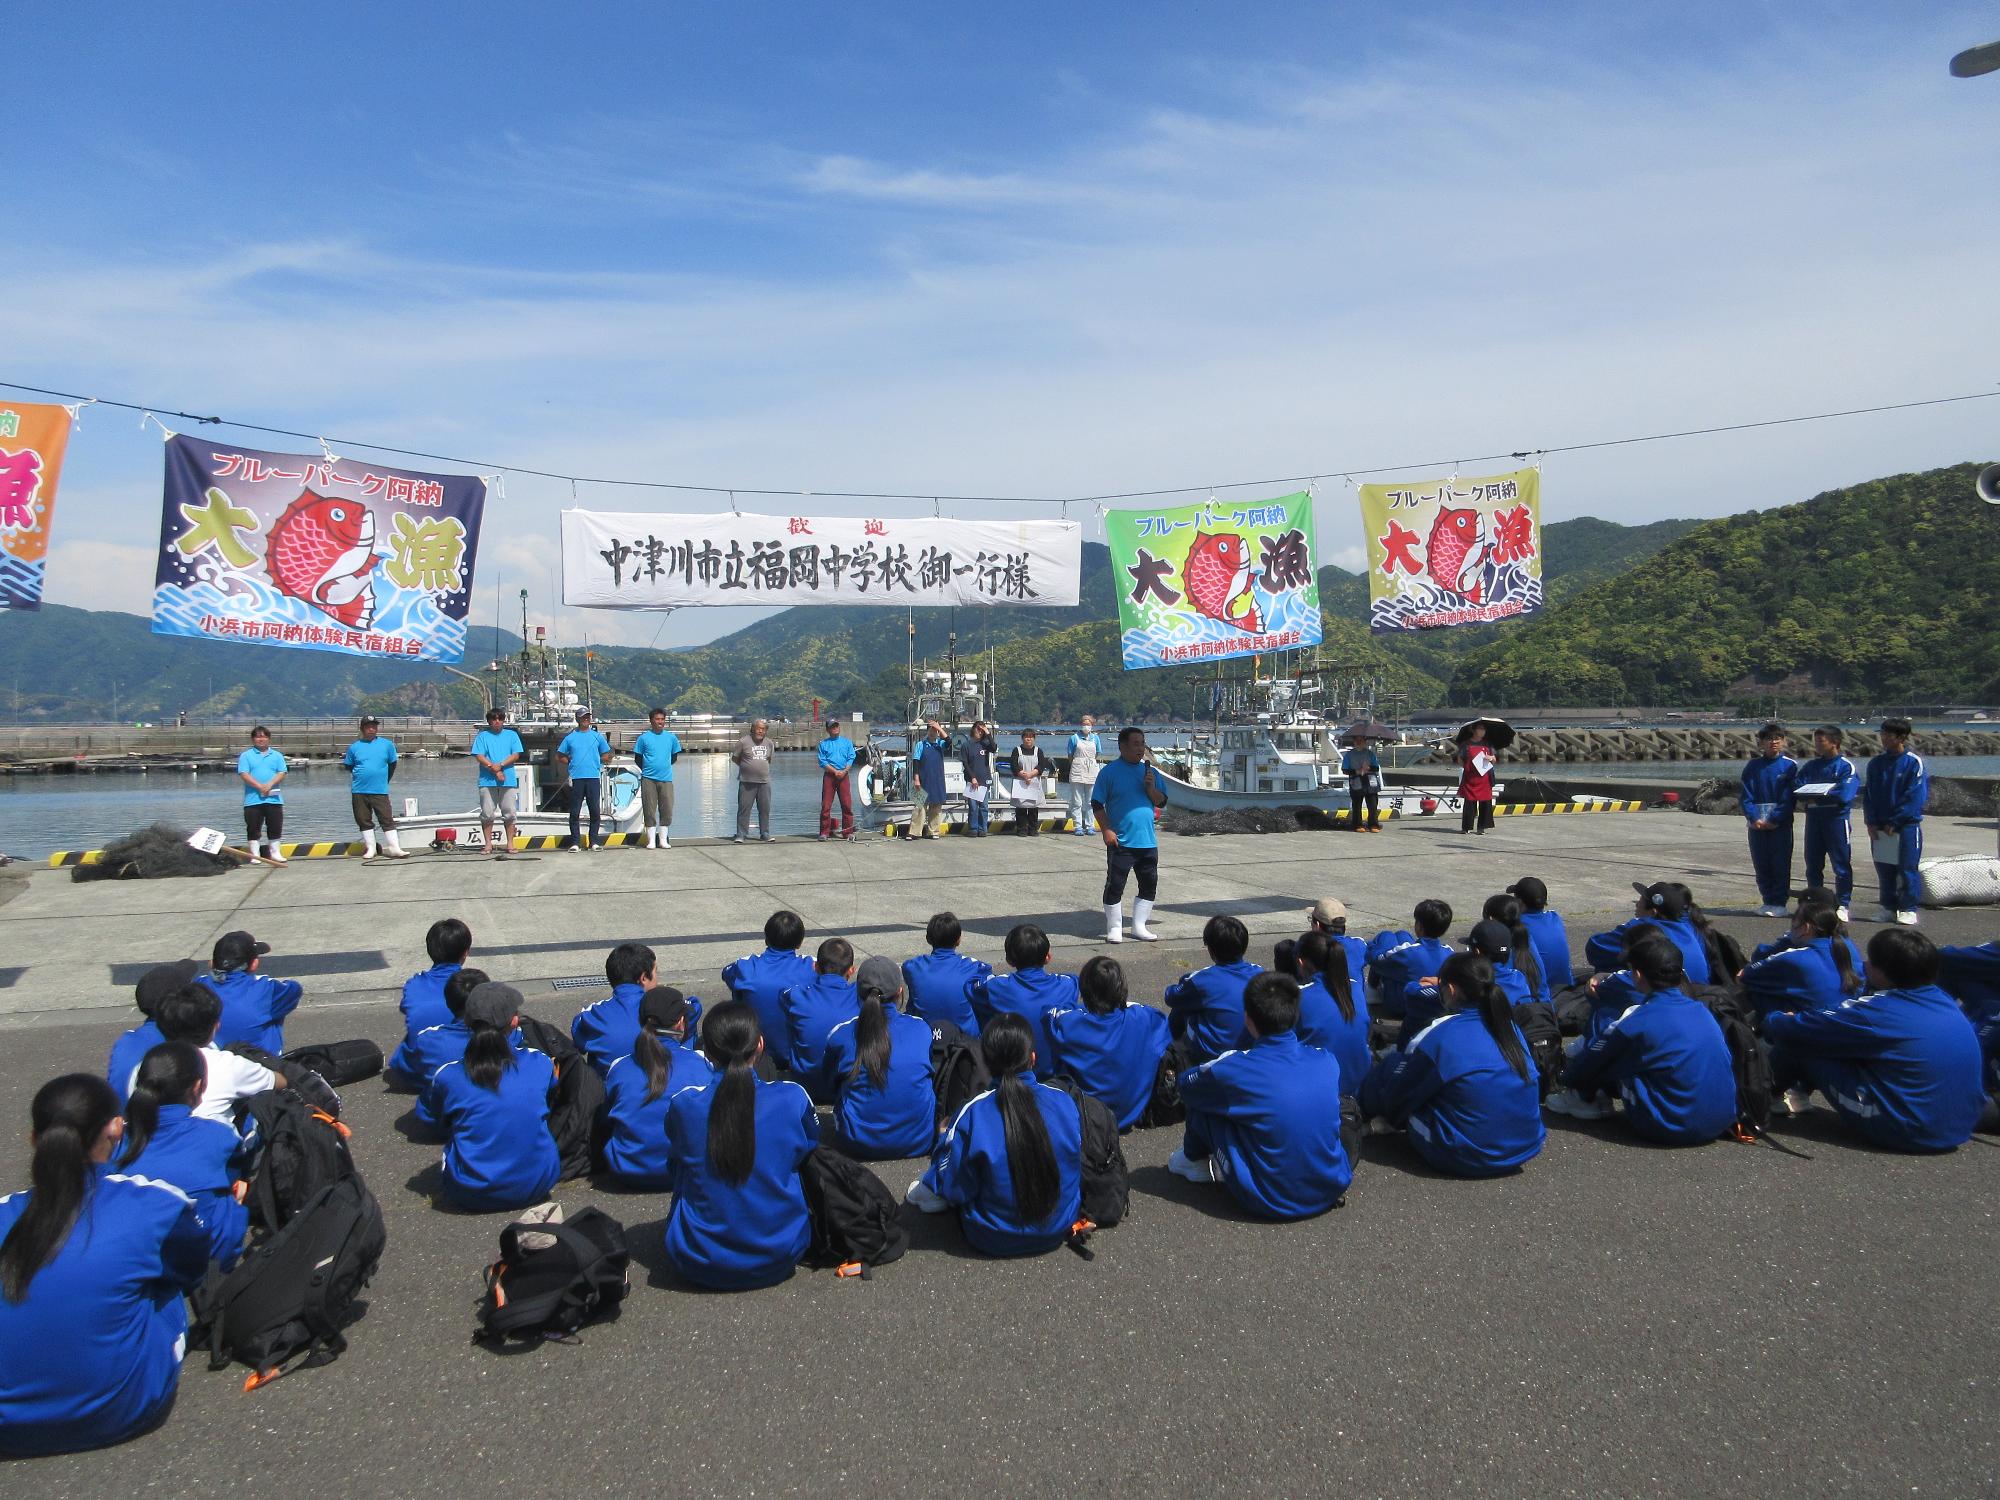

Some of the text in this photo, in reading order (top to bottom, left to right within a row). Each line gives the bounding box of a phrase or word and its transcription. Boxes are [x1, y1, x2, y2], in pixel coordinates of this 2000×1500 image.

[212, 452, 445, 507] ブルーパーク阿納
[1387, 480, 1518, 510] ブルーパーク阿納
[174, 486, 468, 592] 大 漁
[1135, 505, 1287, 537] ブルーパーク阿納
[1379, 502, 1536, 576] 大 漁
[1126, 527, 1314, 606] 大 漁
[1402, 600, 1525, 628] 小浜市阿納体験民宿組合
[199, 613, 424, 656] 小浜市阿納体験民宿組合
[1160, 630, 1301, 661] 小浜市阿納体験民宿組合
[467, 827, 522, 844] 広田
